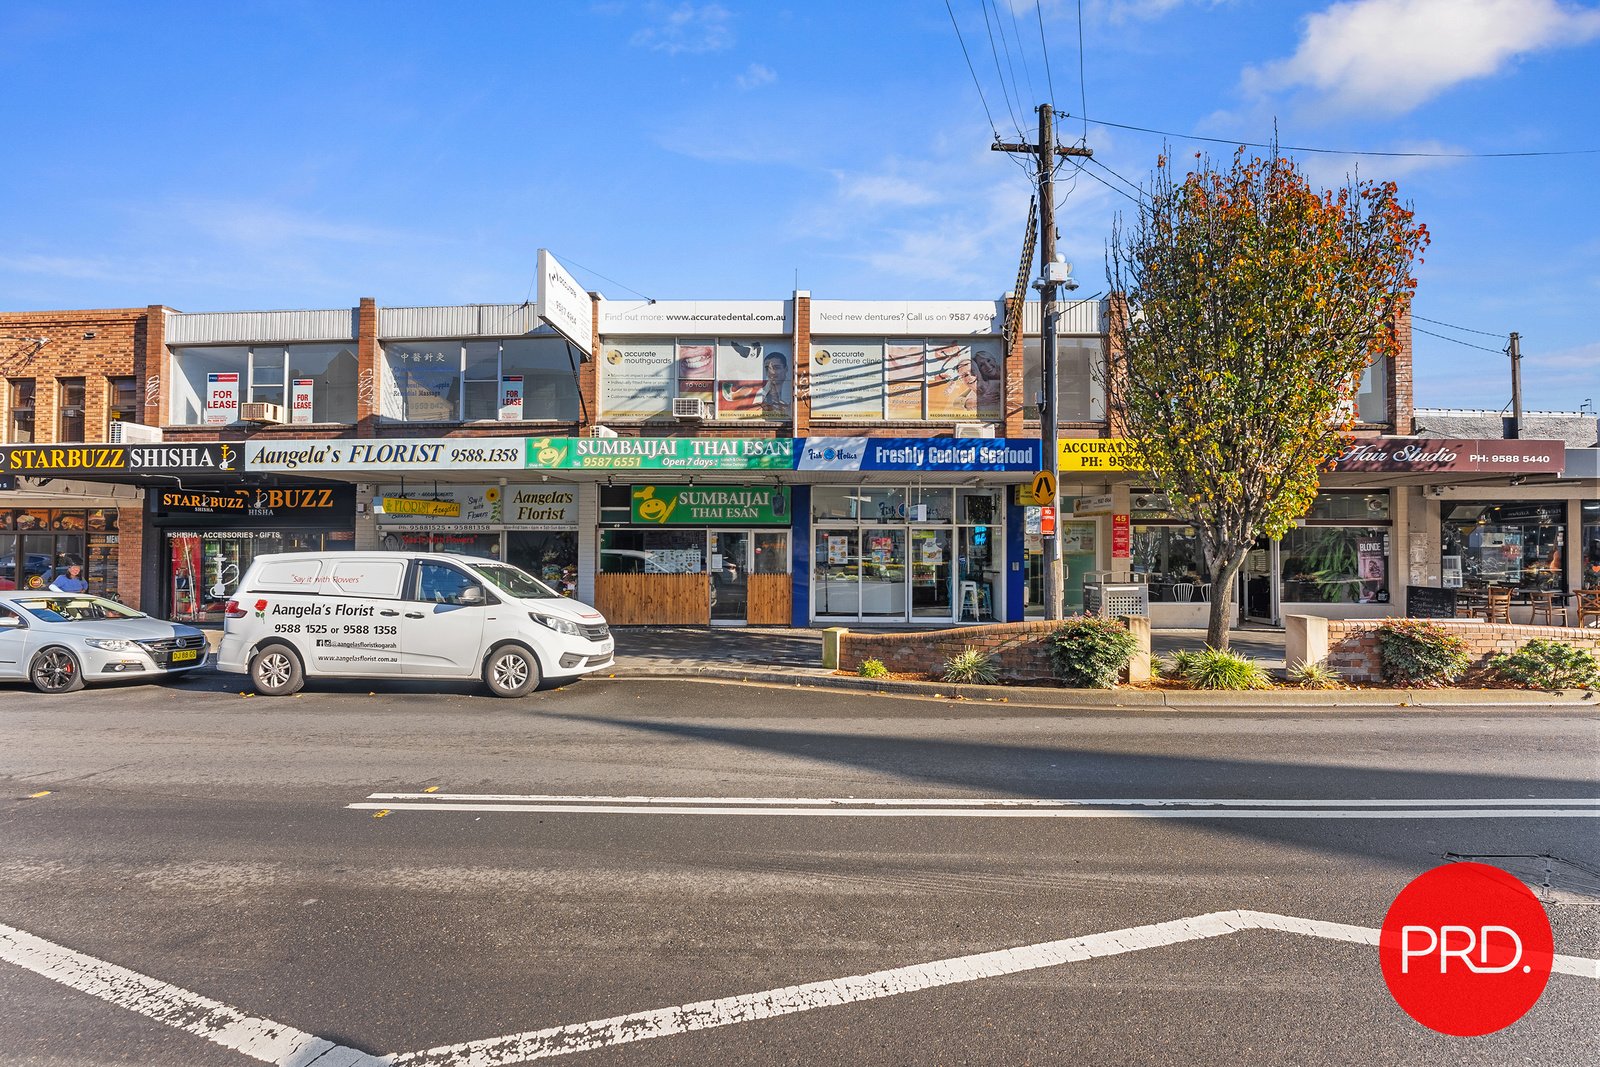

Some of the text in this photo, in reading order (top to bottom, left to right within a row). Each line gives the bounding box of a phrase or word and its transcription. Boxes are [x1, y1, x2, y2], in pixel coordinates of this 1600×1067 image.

[604, 313, 622, 321] Find
[666, 313, 786, 321] www.accuratedental.com.au
[863, 313, 904, 321] dentures?
[906, 313, 922, 321] Call
[251, 444, 518, 468] Aangela's FLORIST 9588.1358
[576, 440, 790, 459] SUMBAIJAI THAI ESAN
[808, 448, 857, 460] Fish Holics
[876, 446, 1033, 466] Freshly Cooked Seafood
[1335, 444, 1550, 464] Hair Studio PH: 9588 5440
[10, 448, 215, 469] STARBUZZ SHISHA
[583, 458, 611, 467] 9587
[614, 458, 641, 467] 6551
[662, 458, 685, 467] Open
[1081, 457, 1102, 466] PH:
[163, 493, 200, 506] STAR
[210, 497, 244, 508] BUZZ
[268, 489, 334, 508] BUZZ
[513, 490, 573, 505] Aangela's
[679, 492, 770, 509] SUMBAIJAI
[395, 500, 430, 513] FLORIST
[691, 508, 758, 518] THAI ESAN
[878, 502, 896, 516] Fish
[517, 507, 565, 520] Florist
[1360, 543, 1381, 551] BLONDE
[272, 604, 374, 618] Aangela's Florist
[274, 624, 300, 633] 9588
[305, 625, 327, 634] 1525
[343, 625, 369, 634] 9588
[374, 626, 397, 635] 1358
